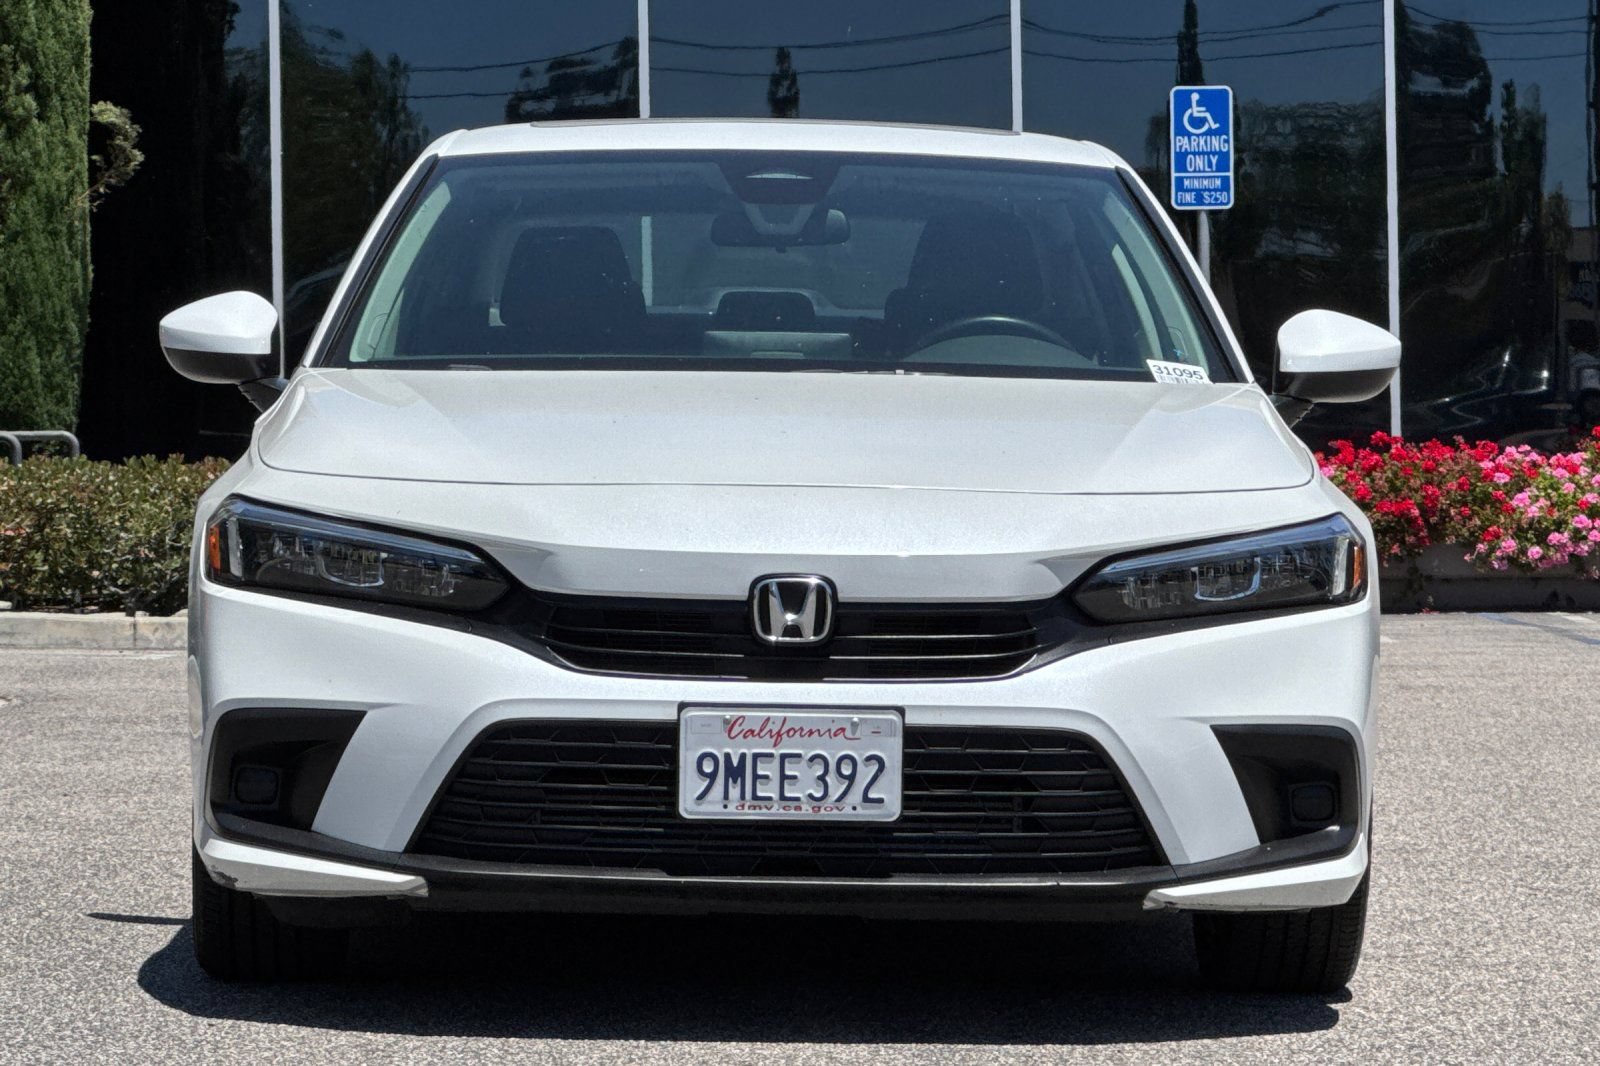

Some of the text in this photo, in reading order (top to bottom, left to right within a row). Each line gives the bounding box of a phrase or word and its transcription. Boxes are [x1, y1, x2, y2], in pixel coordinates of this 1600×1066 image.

[1175, 135, 1229, 152] PARKING
[1186, 154, 1218, 171] ONLY
[1183, 178, 1221, 189] MINIMUM
[1177, 191, 1227, 203] FINE $250
[1152, 365, 1203, 380] 31095
[726, 715, 861, 748] California
[695, 751, 886, 804] 9MEE392
[735, 803, 846, 814] dmv.ca.gov
